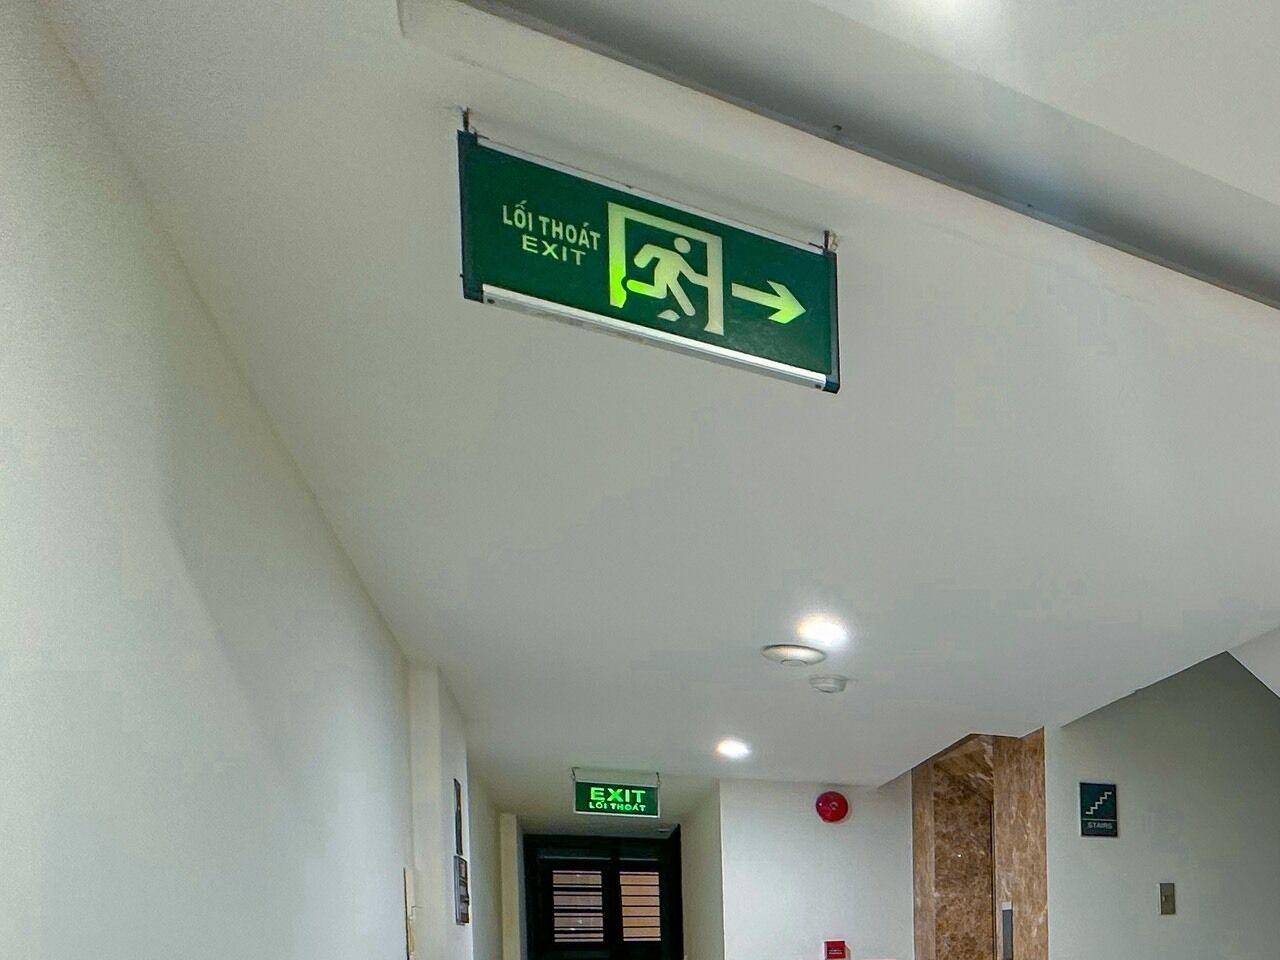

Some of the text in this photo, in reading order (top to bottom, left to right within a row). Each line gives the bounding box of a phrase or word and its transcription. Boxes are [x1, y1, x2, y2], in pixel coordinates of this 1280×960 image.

[502, 199, 601, 251] LỐI THOÁT
[522, 233, 587, 266] EXIT
[590, 787, 646, 803] EXIT
[610, 803, 646, 812] THOÁT
[1087, 822, 1113, 830] STAIRS
